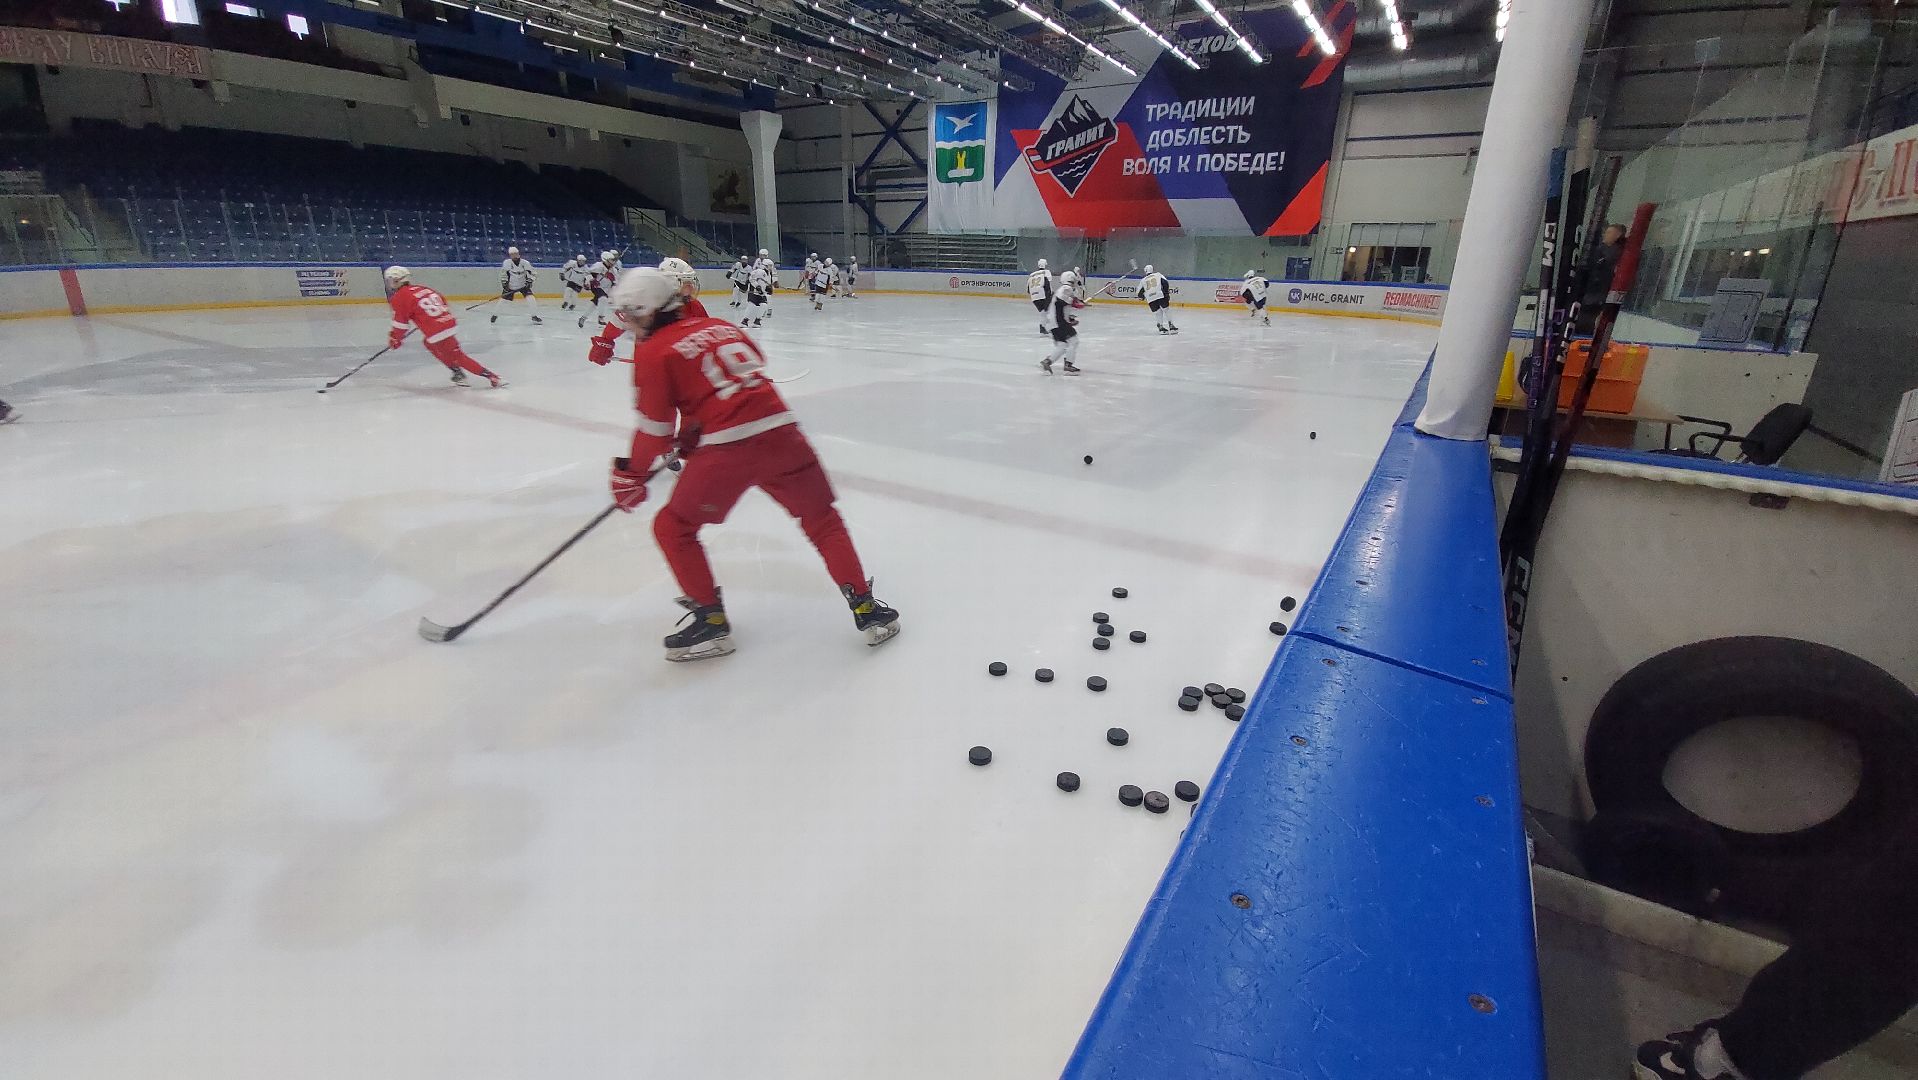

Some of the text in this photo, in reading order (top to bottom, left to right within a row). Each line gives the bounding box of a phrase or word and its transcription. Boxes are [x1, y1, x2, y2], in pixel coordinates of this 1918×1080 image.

[1183, 34, 1238, 55] ЕХОВ
[1145, 96, 1256, 122] ТРАДИЦИИ
[1046, 122, 1107, 161] ГРАНИТ
[1146, 125, 1252, 152] ДОБЛЕСТЬ
[1122, 151, 1286, 176] ВОЛЯ К ПОБЕДЕ!
